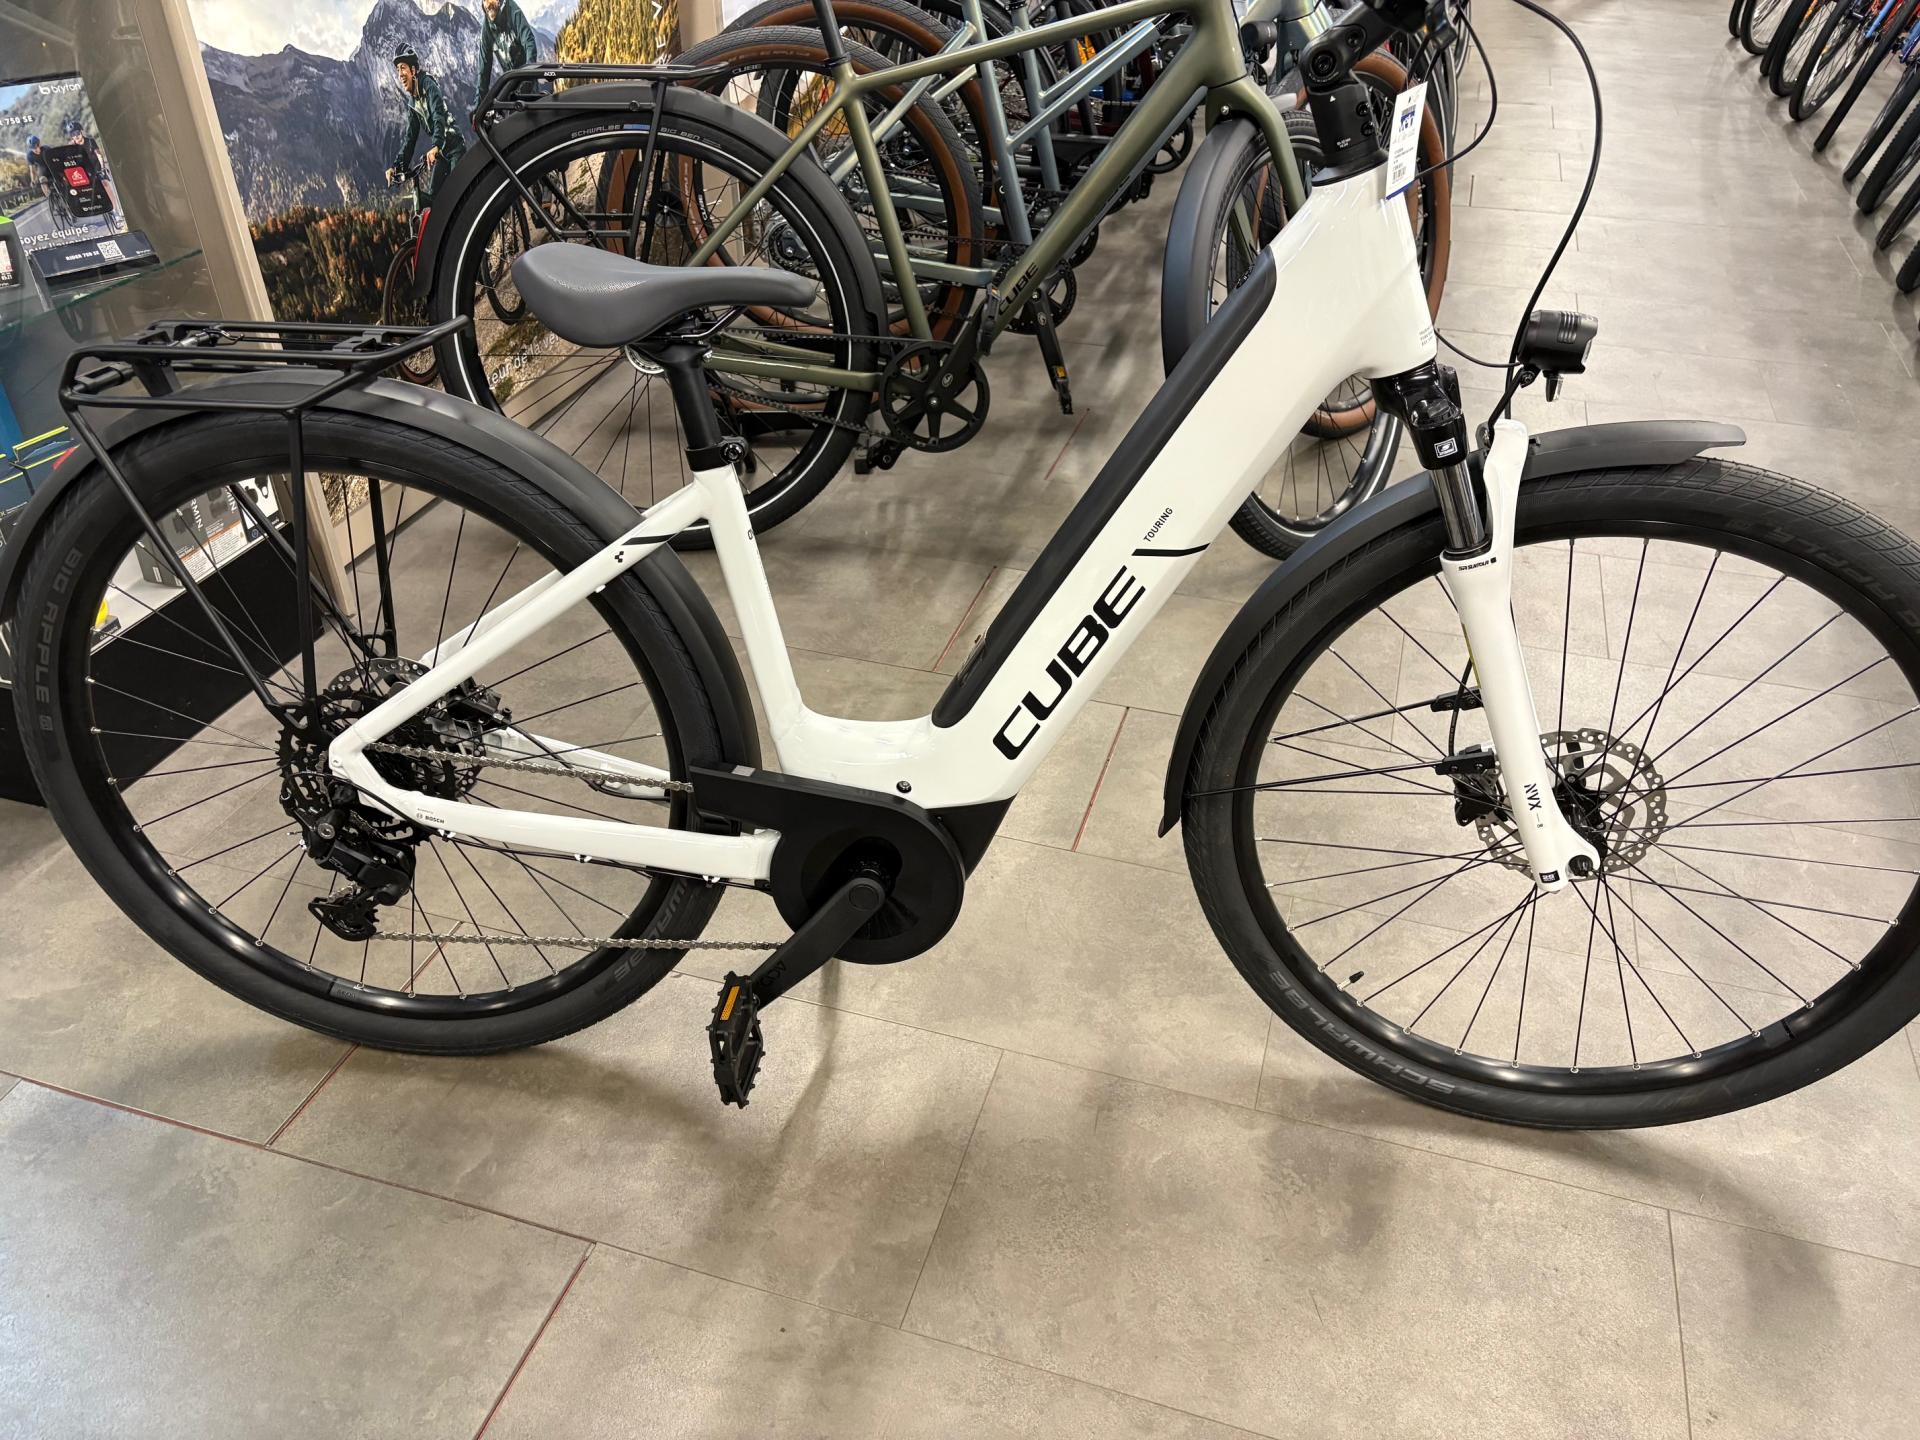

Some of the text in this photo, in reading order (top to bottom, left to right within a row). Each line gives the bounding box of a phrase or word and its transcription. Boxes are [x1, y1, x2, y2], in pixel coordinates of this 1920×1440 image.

[732, 64, 762, 75] CUBE
[50, 83, 82, 95] bryton
[22, 115, 33, 123] SE
[571, 124, 621, 139] SCHWALBE
[660, 126, 677, 135] BIG
[680, 131, 700, 141] BEN
[51, 223, 89, 241] équipé
[999, 262, 1039, 316] CUBE
[1143, 507, 1173, 543] TOURING
[35, 547, 83, 704] BIG APPLE
[993, 565, 1146, 761] CUBE
[425, 815, 445, 824] BOSCH
[1269, 969, 1456, 1095] SCHWALBE
